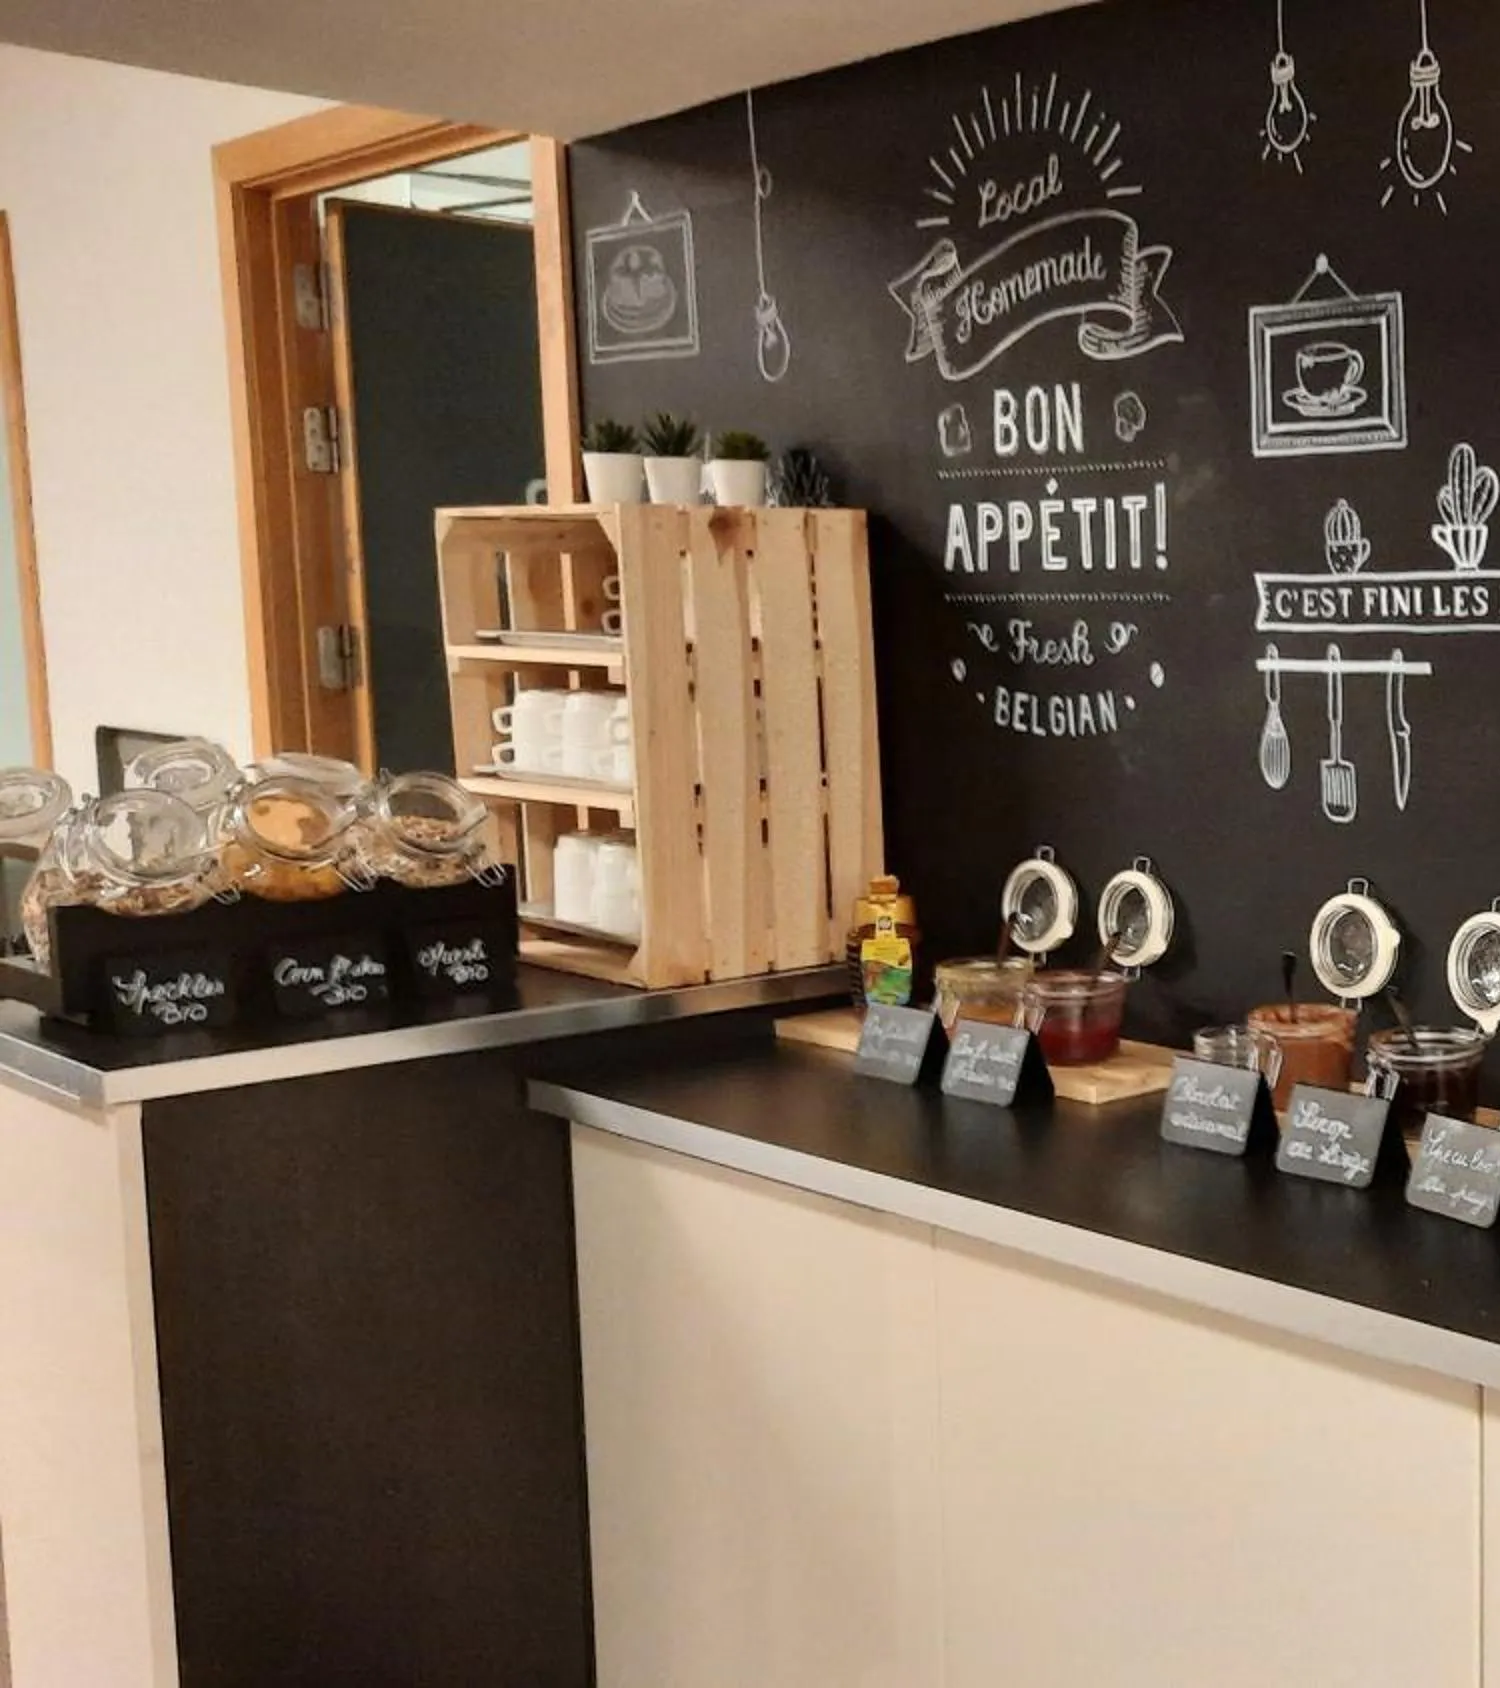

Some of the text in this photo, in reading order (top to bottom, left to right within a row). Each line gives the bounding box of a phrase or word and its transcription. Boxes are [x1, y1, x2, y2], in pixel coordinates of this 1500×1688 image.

[978, 154, 1062, 228] Local
[955, 236, 1106, 343] Homemade
[993, 382, 1085, 456] BON
[1275, 587, 1352, 619] C'EST
[1364, 586, 1424, 617] FINI
[1432, 584, 1490, 617] LES
[1008, 618, 1094, 665] Fresh
[994, 686, 1118, 737] BELGIAN
